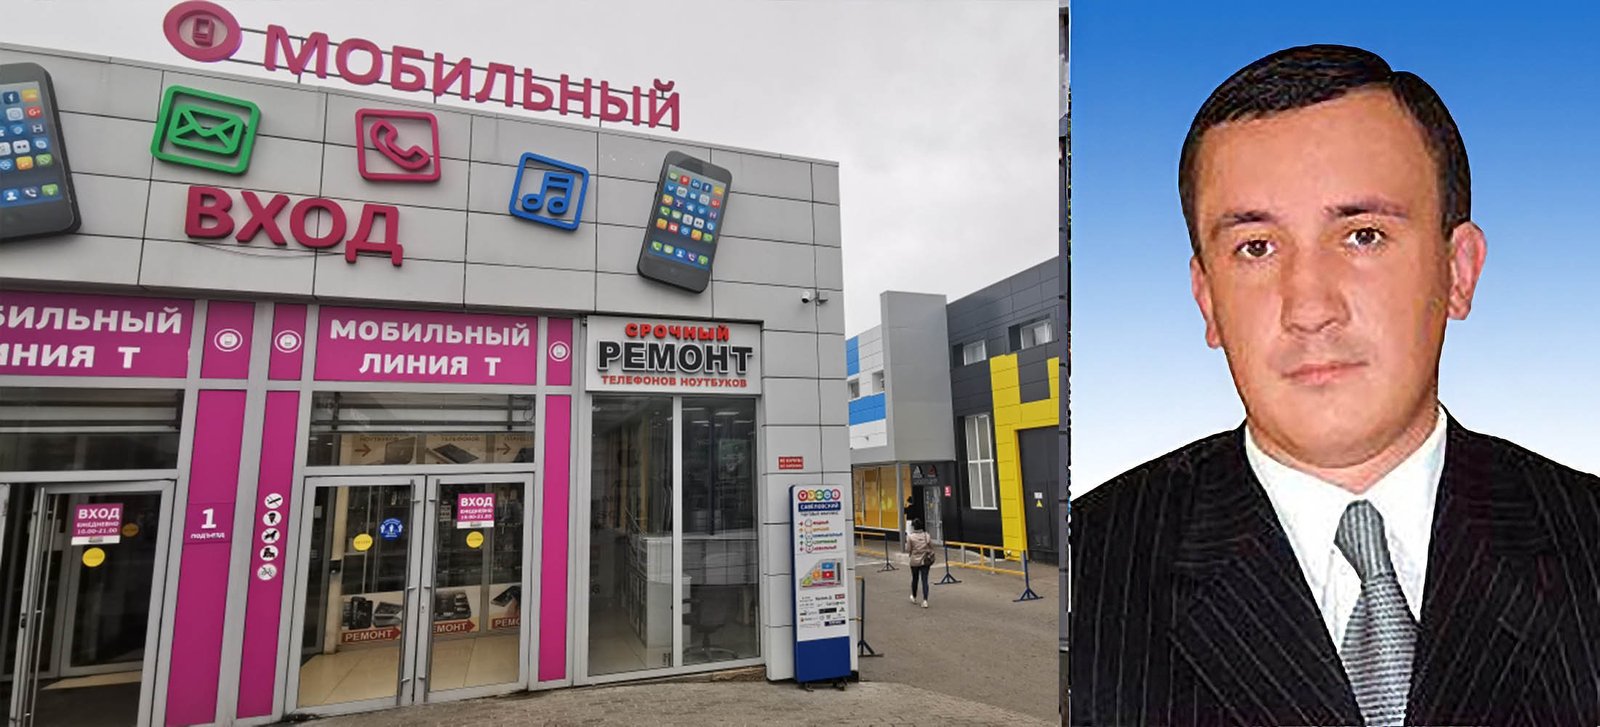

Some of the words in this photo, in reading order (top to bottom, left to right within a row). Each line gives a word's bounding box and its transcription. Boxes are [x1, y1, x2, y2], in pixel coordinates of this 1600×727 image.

[264, 24, 680, 131] МОБИЛЬНЫЙ
[185, 186, 403, 267] ВХОД
[0, 305, 182, 334] ИЛЬНЫЙ
[330, 319, 531, 347] МОБИЛЬНЫЙ
[625, 323, 731, 342] СРОЧНЫЙ
[359, 353, 468, 376] ЛИНИЯ
[597, 341, 754, 375] РЕМОНТ
[602, 375, 677, 386] ТЕЛЕФОНОВ
[680, 377, 748, 388] НОУТБУКОВ
[460, 497, 494, 507] ВХОД
[78, 508, 120, 520] ВХОД
[201, 508, 217, 529] 1
[345, 629, 393, 643] РЕМОНТ
